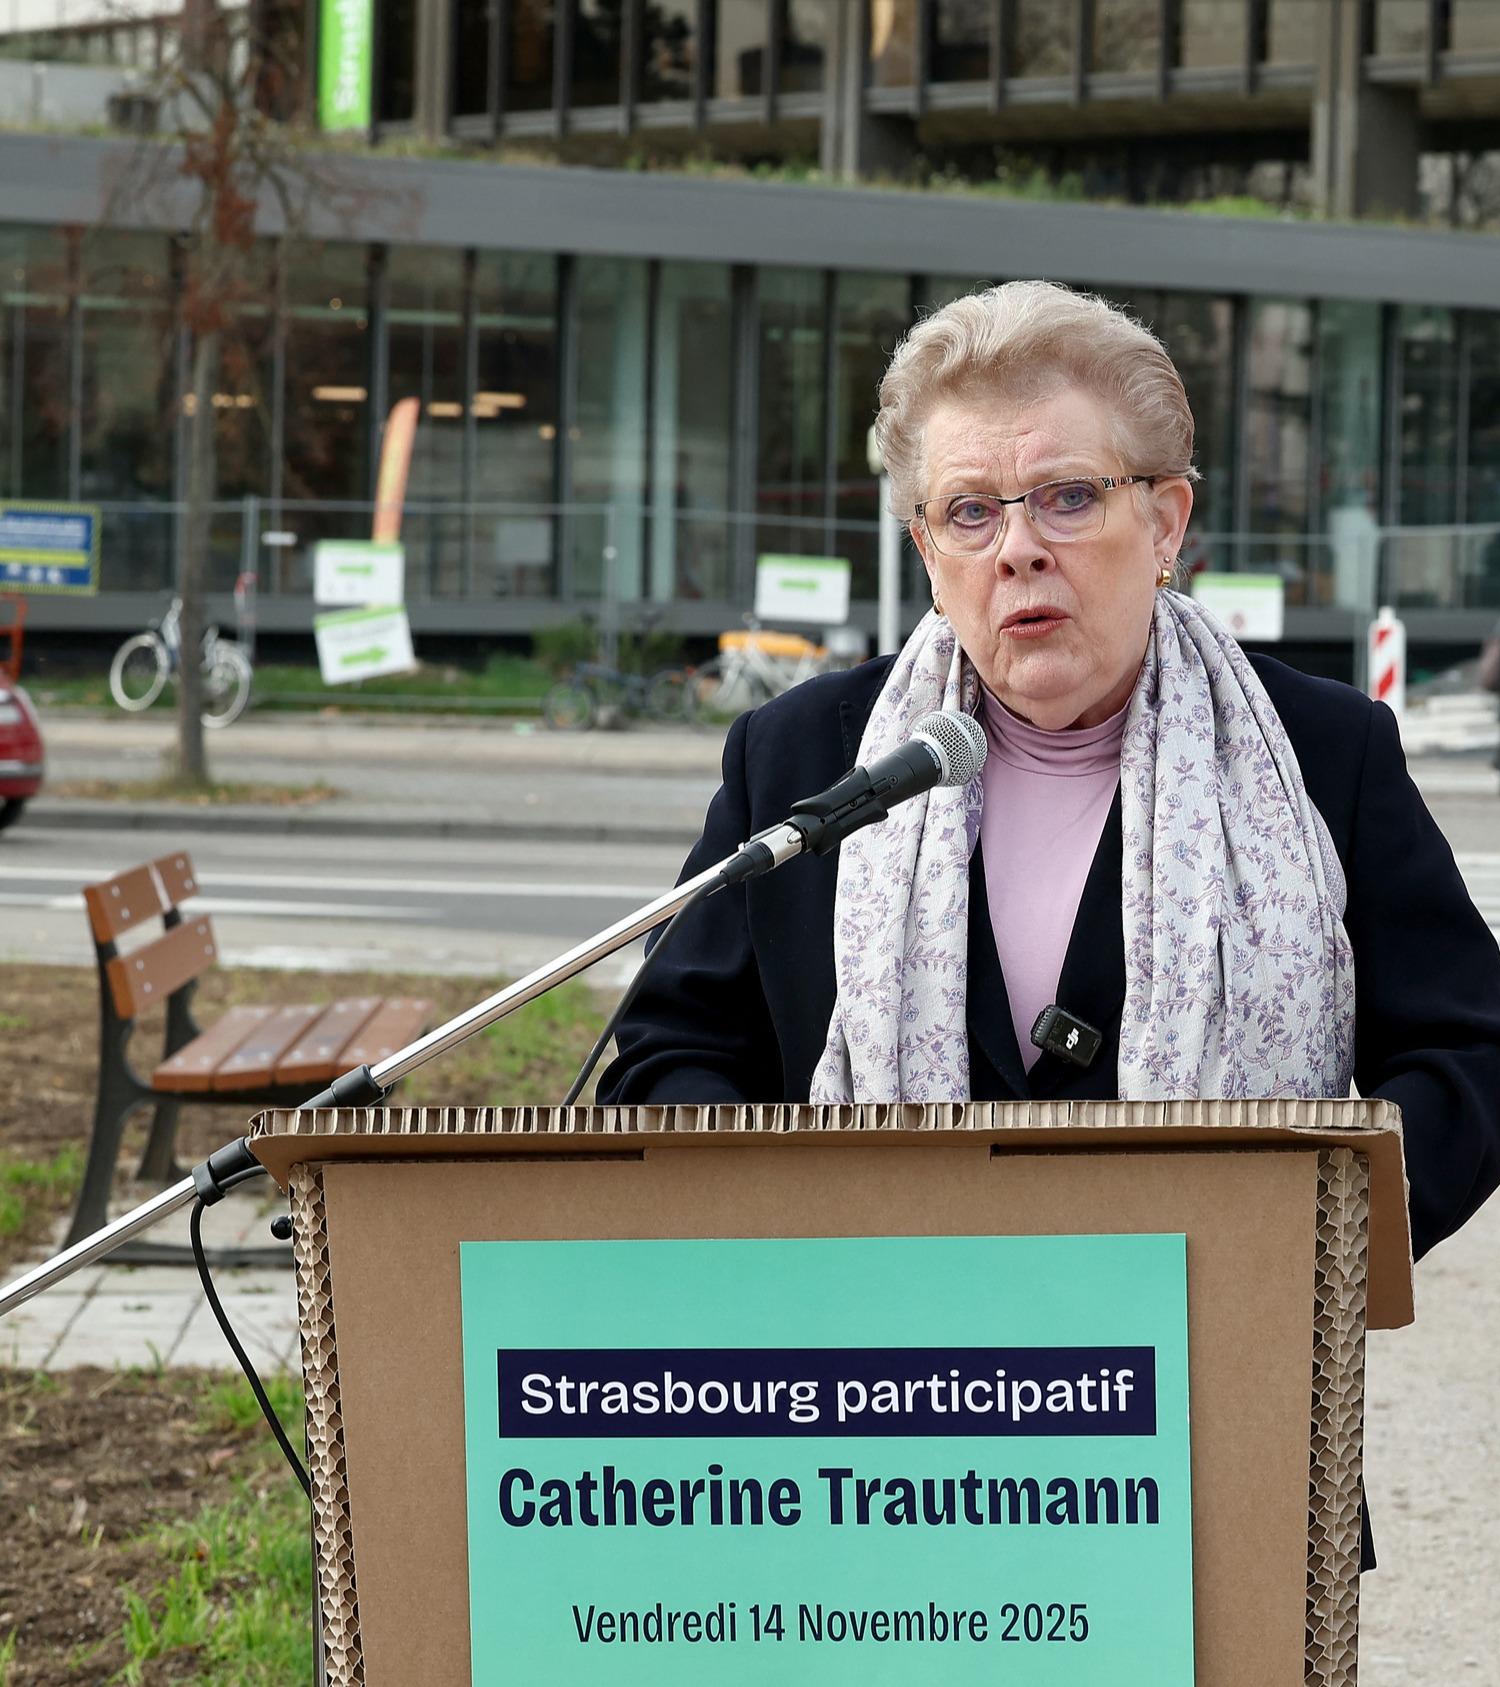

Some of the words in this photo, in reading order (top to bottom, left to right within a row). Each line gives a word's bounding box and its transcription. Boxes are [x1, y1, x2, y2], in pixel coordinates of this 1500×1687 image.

[521, 1371, 820, 1423] Strasbourg
[837, 1368, 1134, 1422] participatif
[498, 1463, 802, 1528] Catherine
[817, 1467, 1160, 1526] Trautmann
[571, 1602, 737, 1643] Vendredi
[749, 1604, 786, 1642] 14
[798, 1601, 988, 1642] Novembre
[1000, 1602, 1089, 1642] 2025
